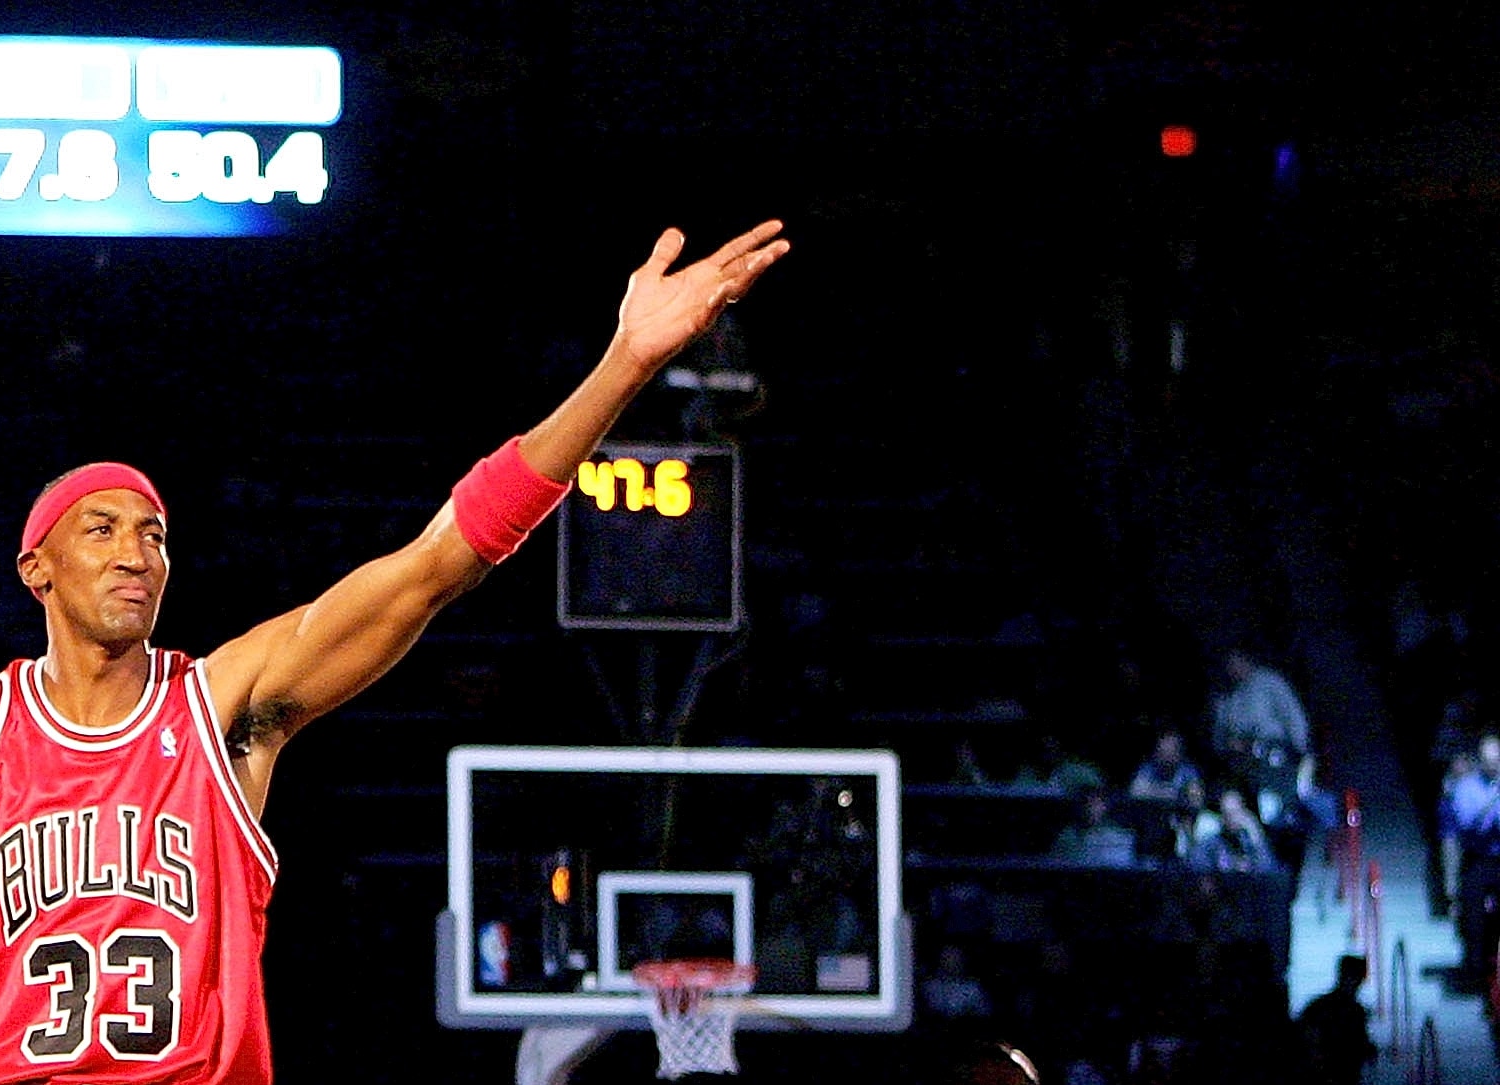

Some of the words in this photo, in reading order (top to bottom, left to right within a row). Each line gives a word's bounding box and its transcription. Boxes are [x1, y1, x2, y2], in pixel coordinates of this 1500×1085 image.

[148, 130, 329, 205] 50.4
[578, 457, 692, 517] 47.6
[20, 928, 182, 1064] 33
